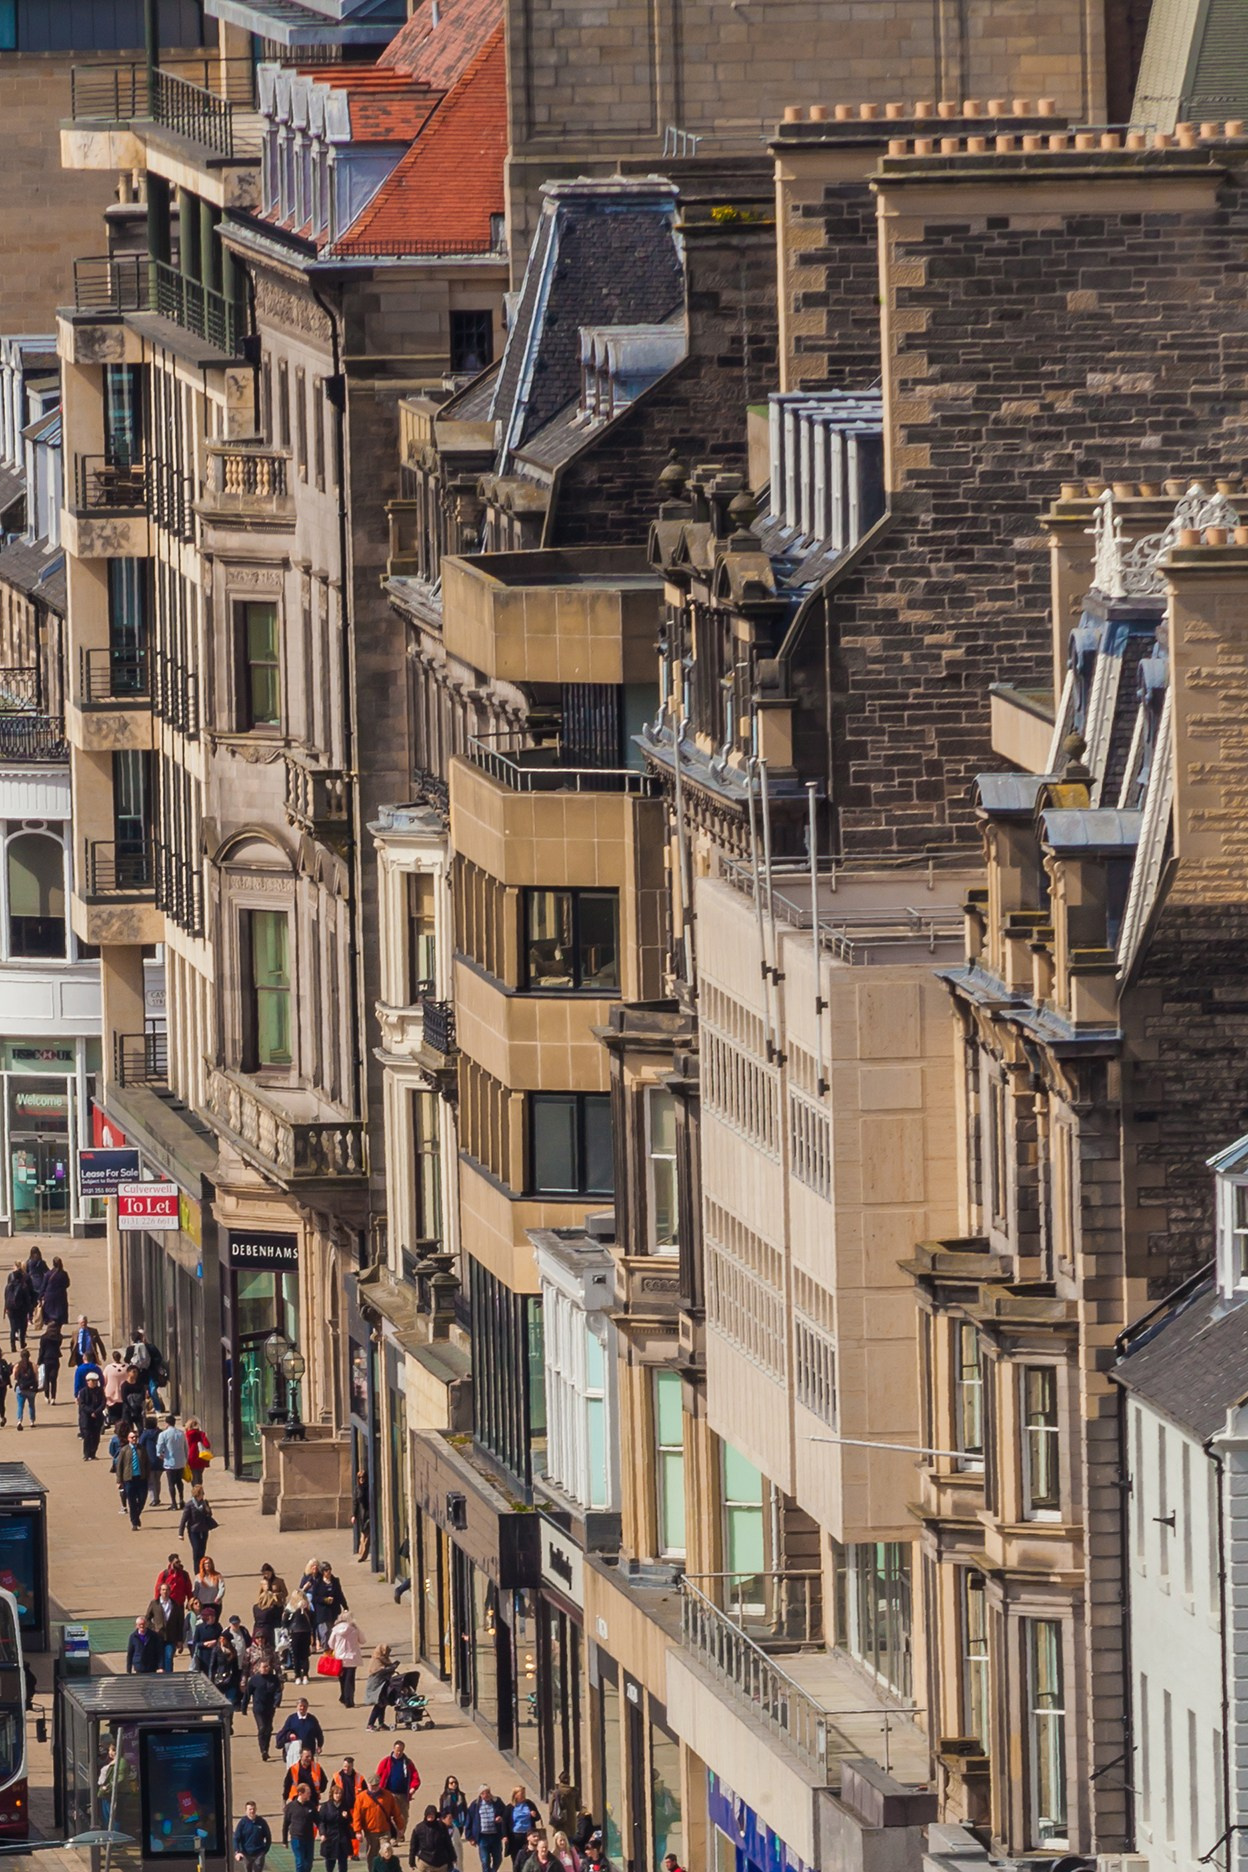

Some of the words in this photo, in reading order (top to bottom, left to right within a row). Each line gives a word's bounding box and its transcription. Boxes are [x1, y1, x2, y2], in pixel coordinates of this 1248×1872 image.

[16, 1093, 63, 1107] Welcome
[81, 1169, 105, 1178] Lease
[105, 1168, 119, 1177] For
[120, 1168, 139, 1177] Sale
[123, 1184, 172, 1194] Culverwell
[124, 1197, 144, 1214] To
[146, 1197, 172, 1214] Let
[231, 1243, 299, 1259] DEBENHAMS
